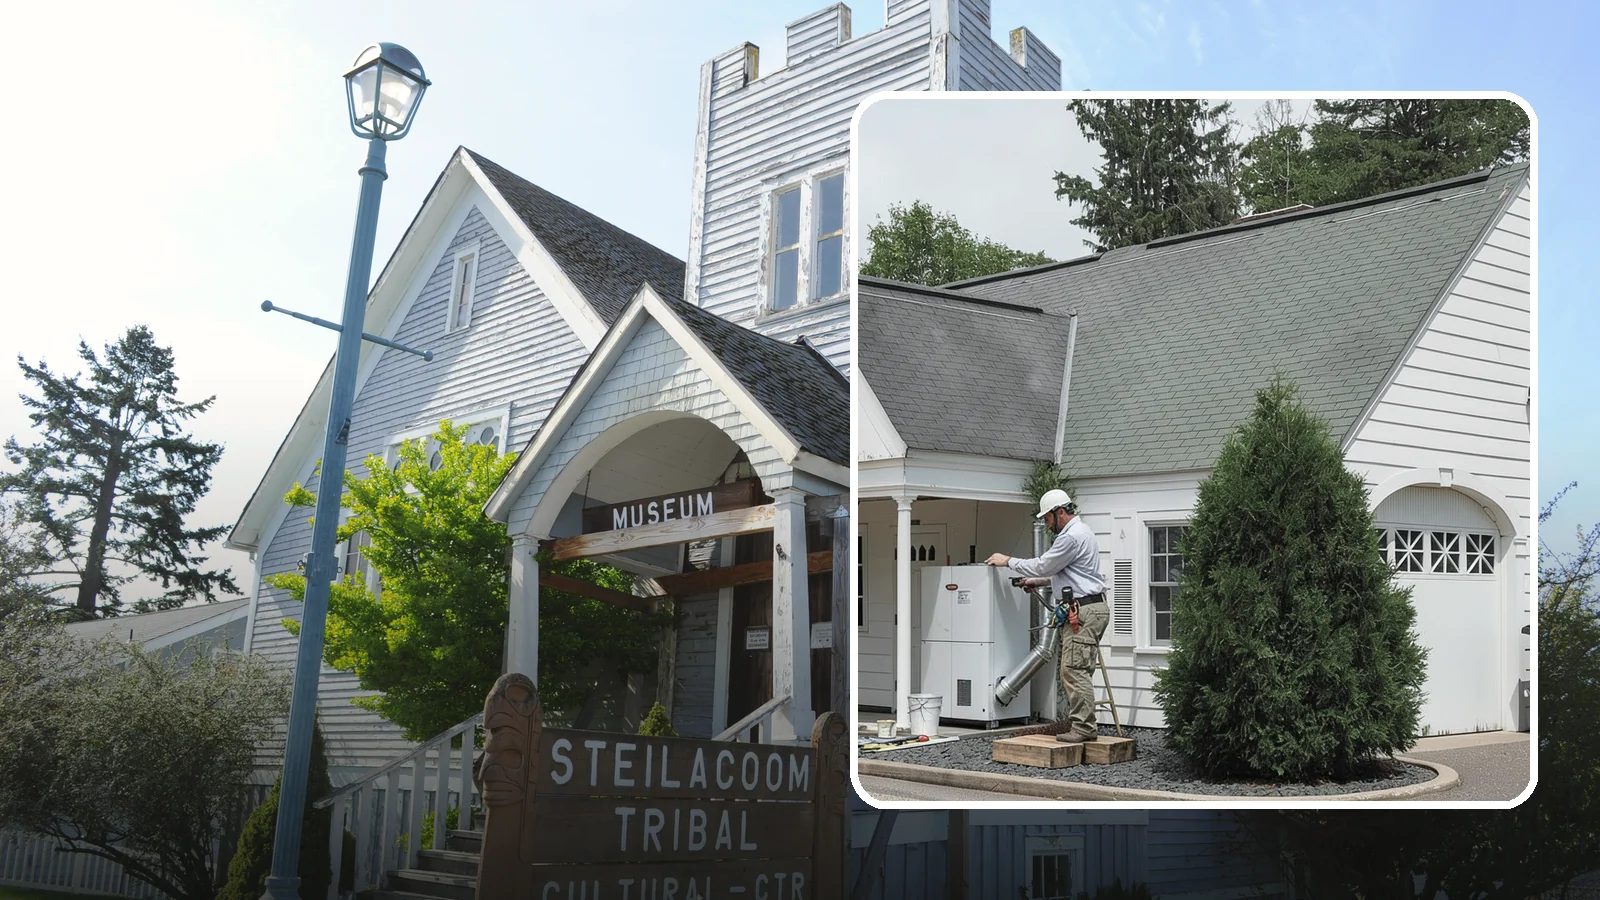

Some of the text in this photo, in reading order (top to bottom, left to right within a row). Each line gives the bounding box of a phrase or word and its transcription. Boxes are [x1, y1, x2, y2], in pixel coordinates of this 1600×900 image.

[612, 491, 714, 531] MUSEUM
[550, 738, 809, 793] STEILACOOM
[614, 806, 758, 852] TRIBAL
